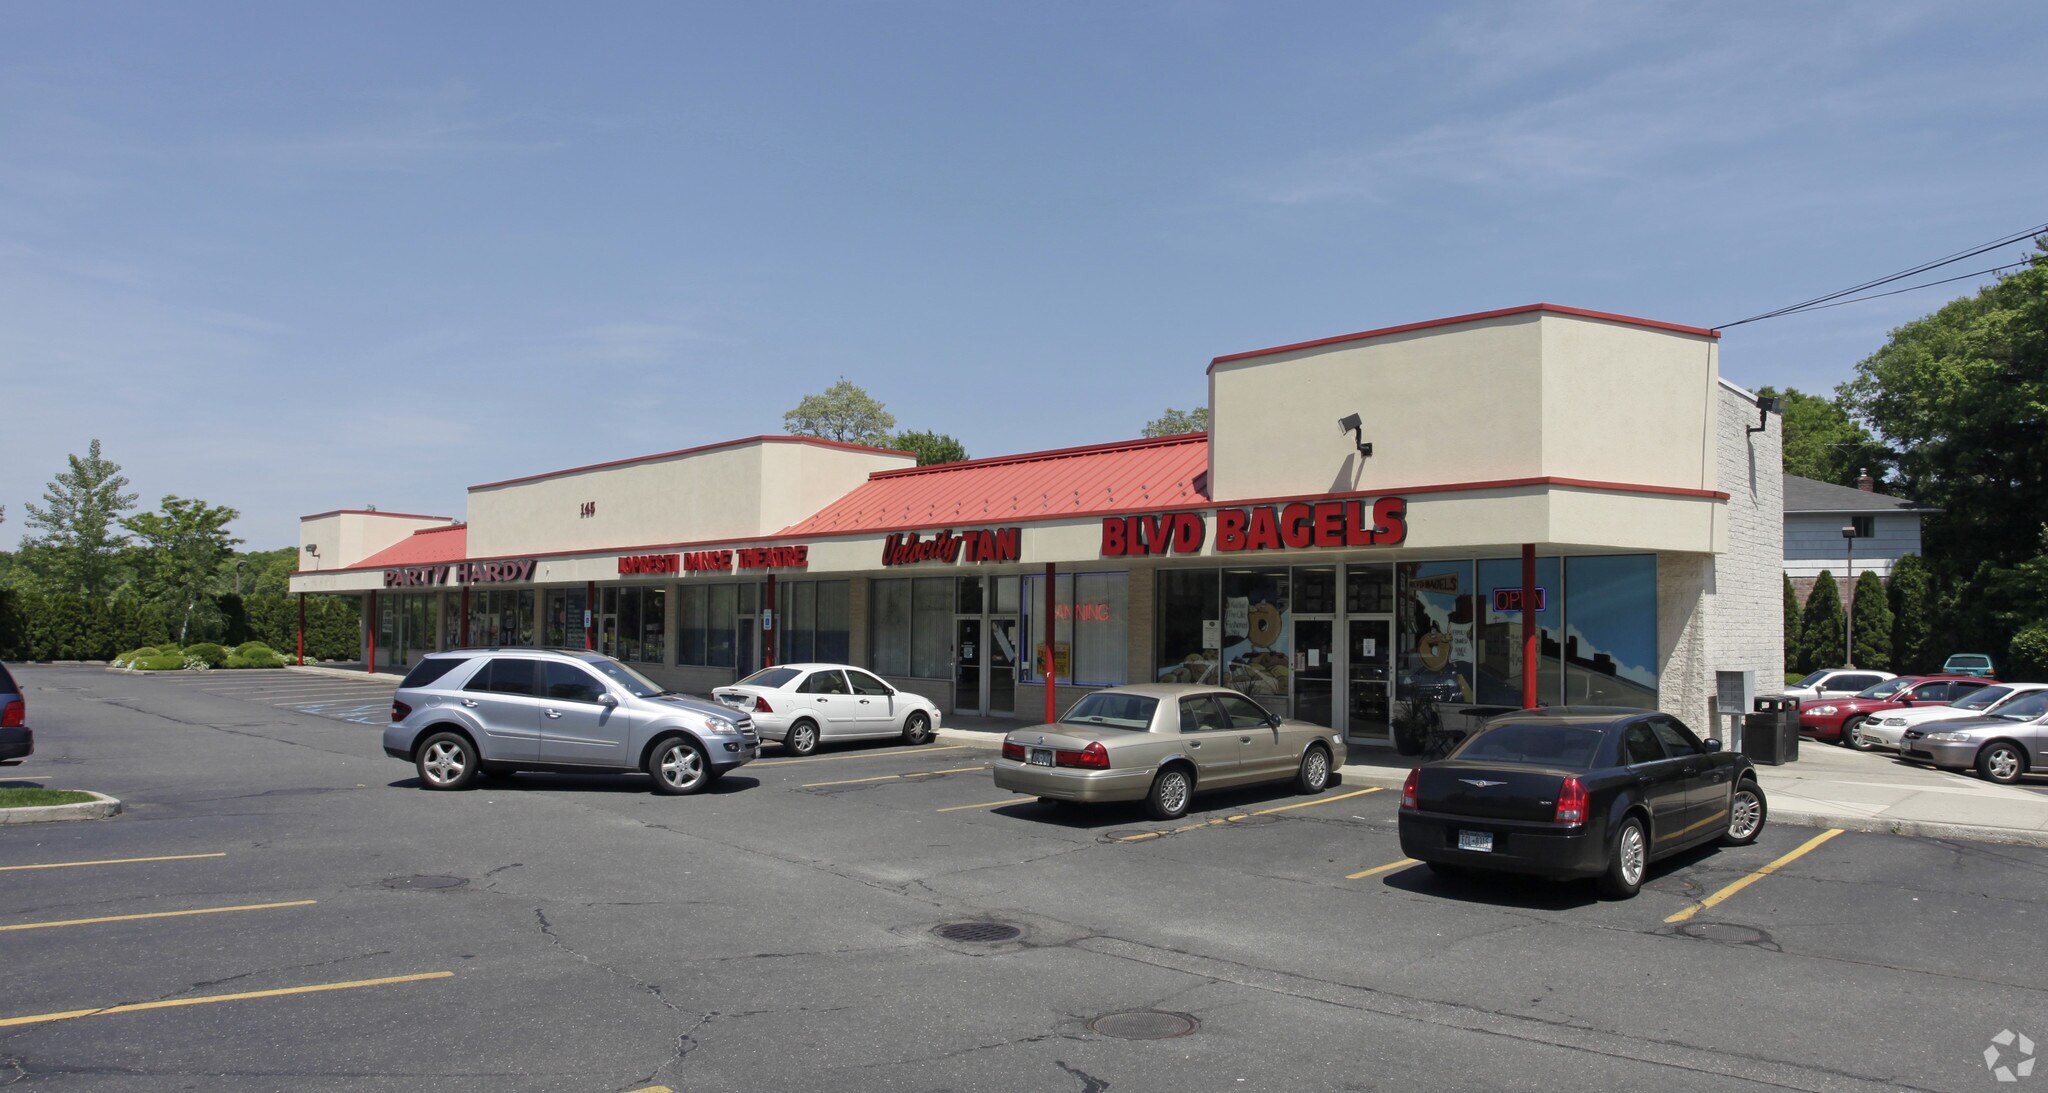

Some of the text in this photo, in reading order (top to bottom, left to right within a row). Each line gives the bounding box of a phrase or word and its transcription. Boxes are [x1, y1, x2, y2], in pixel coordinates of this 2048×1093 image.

[580, 501, 595, 516] 145
[1102, 497, 1408, 556] BLVD BAGELS
[618, 546, 808, 574] LOPRESTI DANCE THEATRE
[882, 527, 1021, 566] Velocity TAN
[384, 559, 538, 587] PARTY HARDY
[1055, 603, 1111, 621] ANNING
[1496, 591, 1544, 610] OPN
